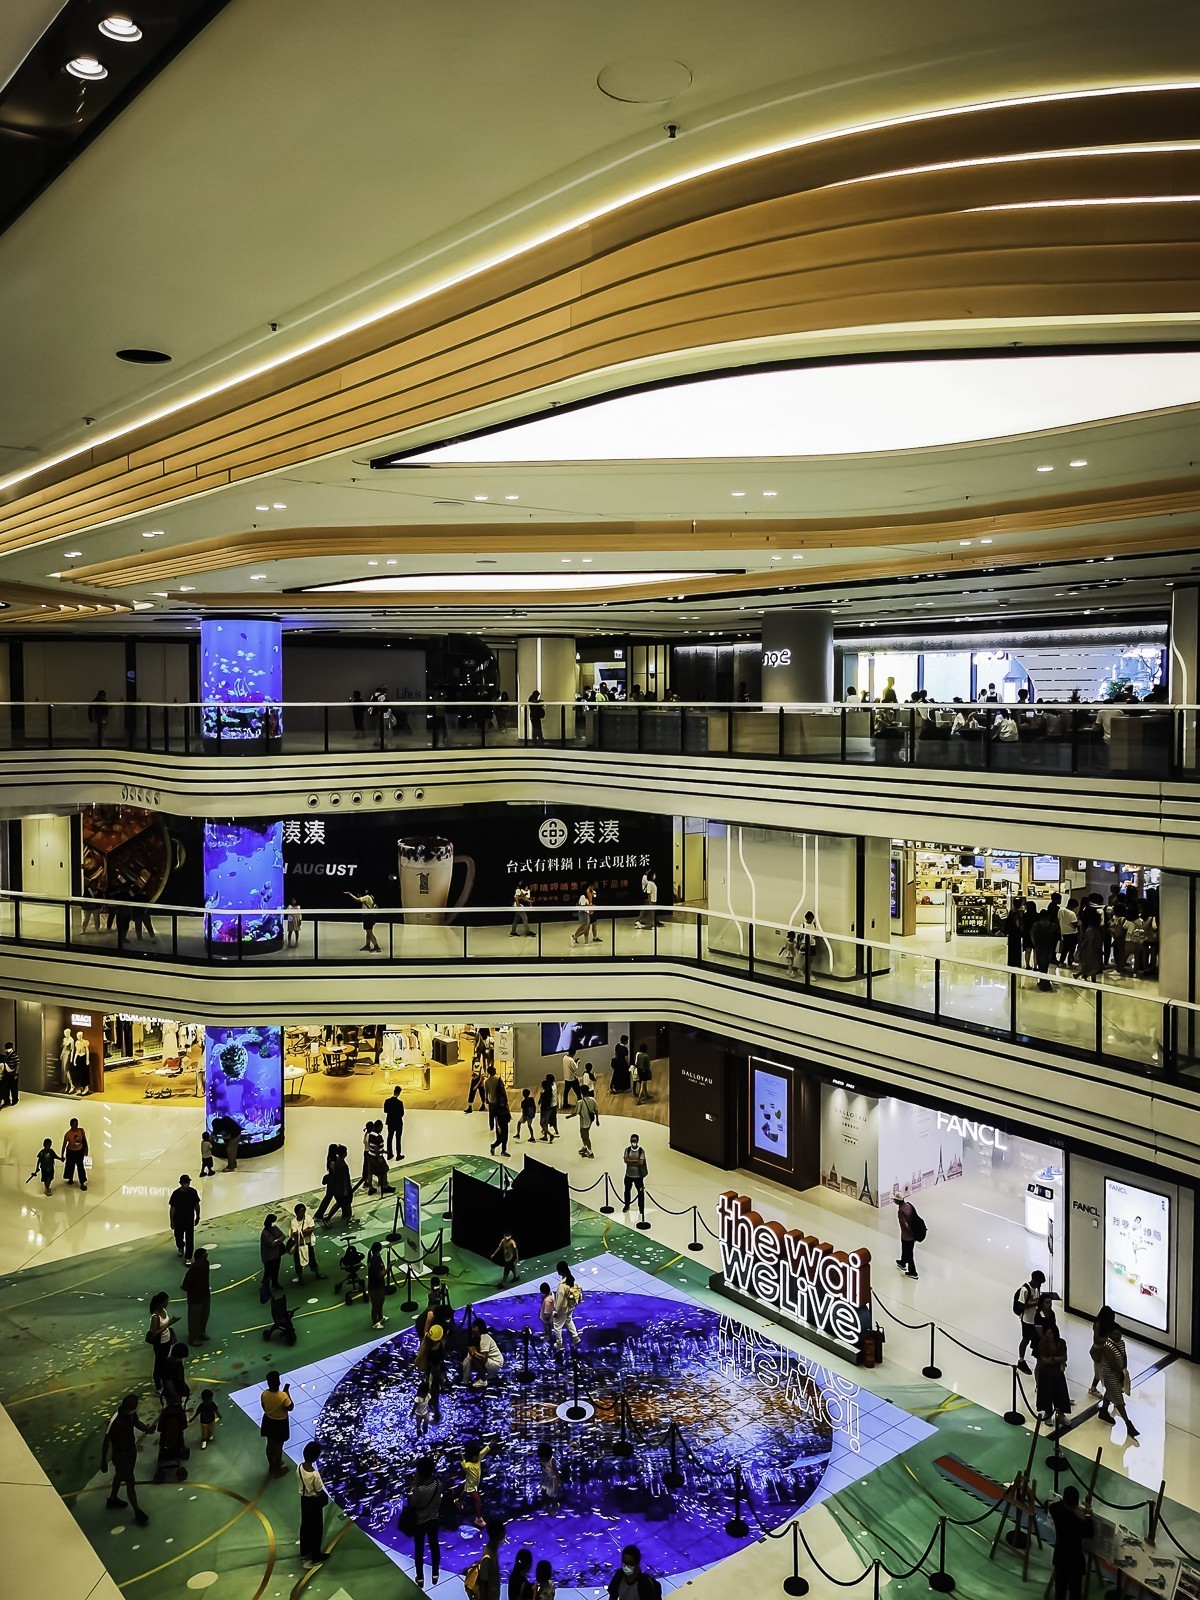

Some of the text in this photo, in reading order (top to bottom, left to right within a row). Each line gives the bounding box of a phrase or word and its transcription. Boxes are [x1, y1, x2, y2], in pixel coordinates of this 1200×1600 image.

[573, 819, 620, 845] 湊湊
[292, 863, 358, 877] AUGUST
[681, 1069, 713, 1085] DALLOYAU
[936, 1110, 1008, 1151] FANCL
[1108, 1183, 1128, 1195] FANCL
[1072, 1200, 1101, 1218] FANCL
[717, 1192, 862, 1308] the wai
